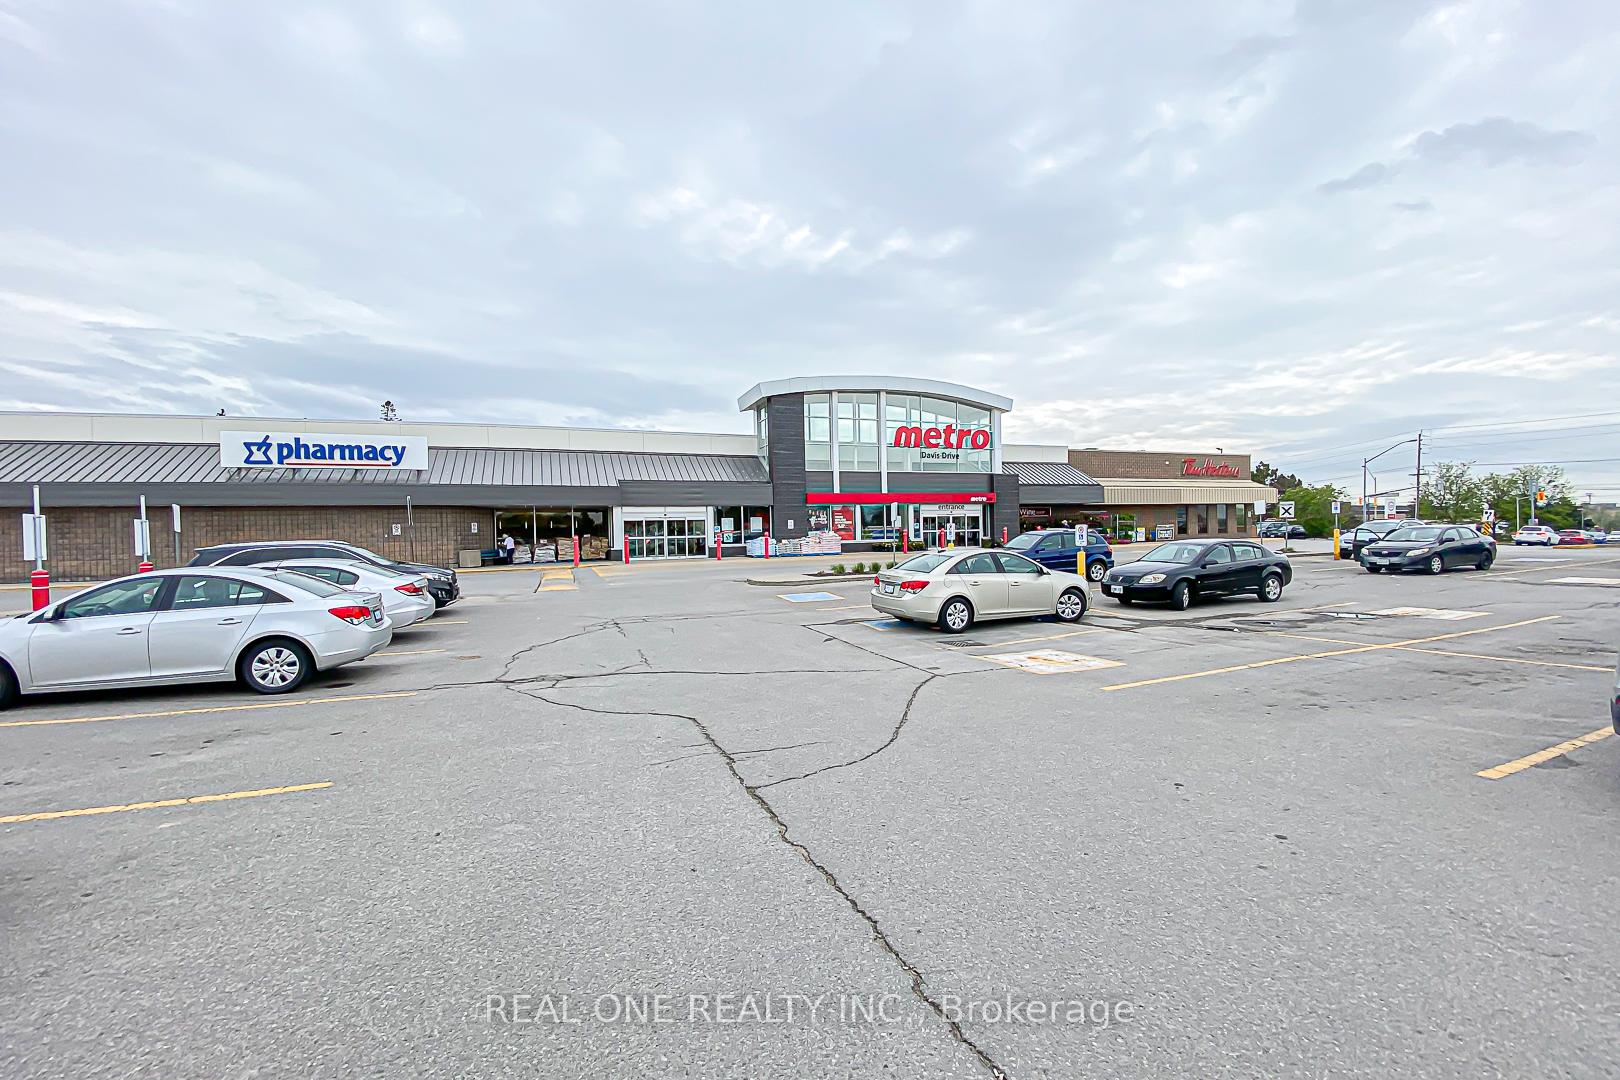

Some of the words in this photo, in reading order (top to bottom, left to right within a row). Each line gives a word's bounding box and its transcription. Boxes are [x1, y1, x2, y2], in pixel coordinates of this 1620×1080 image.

[894, 424, 990, 449] metro
[277, 437, 406, 466] pharmacy
[920, 451, 940, 460] Davis
[941, 452, 961, 460] Drive
